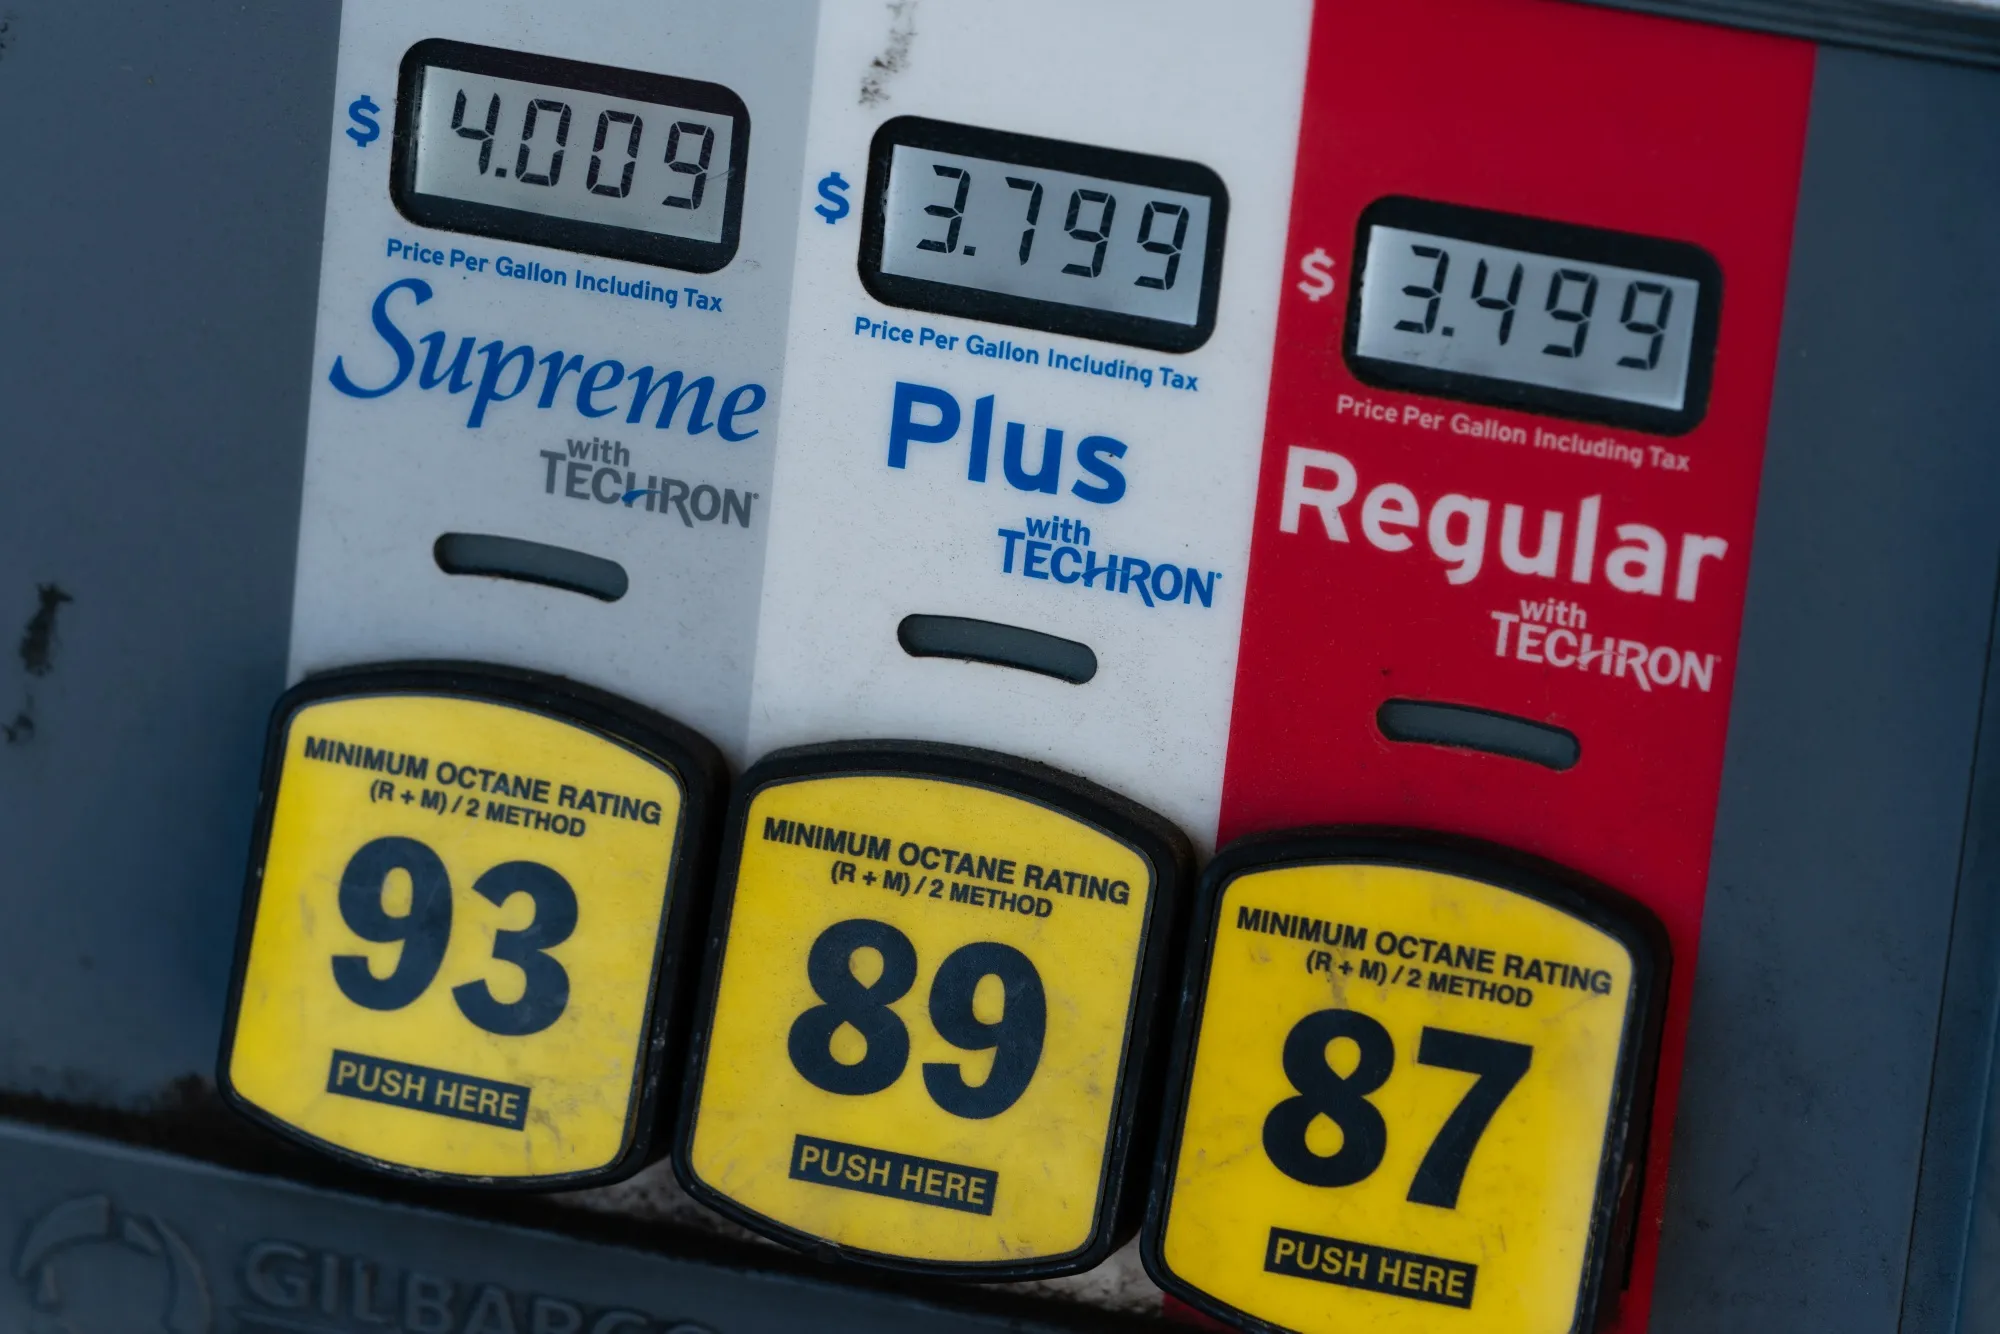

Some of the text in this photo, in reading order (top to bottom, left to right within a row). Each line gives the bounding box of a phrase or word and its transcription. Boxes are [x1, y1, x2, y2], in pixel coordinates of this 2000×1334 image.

[346, 89, 715, 210] $ 4.009
[814, 164, 1190, 291] $ 3.799
[387, 239, 722, 312] Price Per Gallon Including Tax
[1297, 244, 1673, 370] $ 3.499
[328, 278, 766, 442] Supreme
[855, 316, 1198, 392] Price Per Gallon Including Tax
[567, 438, 630, 468] with
[887, 381, 1129, 504] Plus
[1337, 395, 1690, 472] Price Per Gallon Including Tax
[1026, 517, 1091, 546] with
[1278, 445, 1729, 602] Regular
[1519, 599, 1587, 629] with
[304, 736, 662, 826] MINIMUM OCTANE RATING
[485, 803, 586, 837] METHOD
[763, 816, 1130, 906] MINIMUM OCTANE RATING
[950, 883, 1053, 918] METHOD
[331, 835, 579, 1037] 93
[1236, 906, 1613, 996] MINIMUM OCTANE RATING
[787, 918, 1047, 1120] 89
[1427, 973, 1534, 1008] METHOD
[335, 1060, 521, 1121] PUSH HERE
[1262, 1008, 1534, 1210] 87
[799, 1145, 987, 1205] PUSH HERE
[243, 1239, 726, 1334] GILBAR
[1274, 1235, 1467, 1299] PUSH HERE
